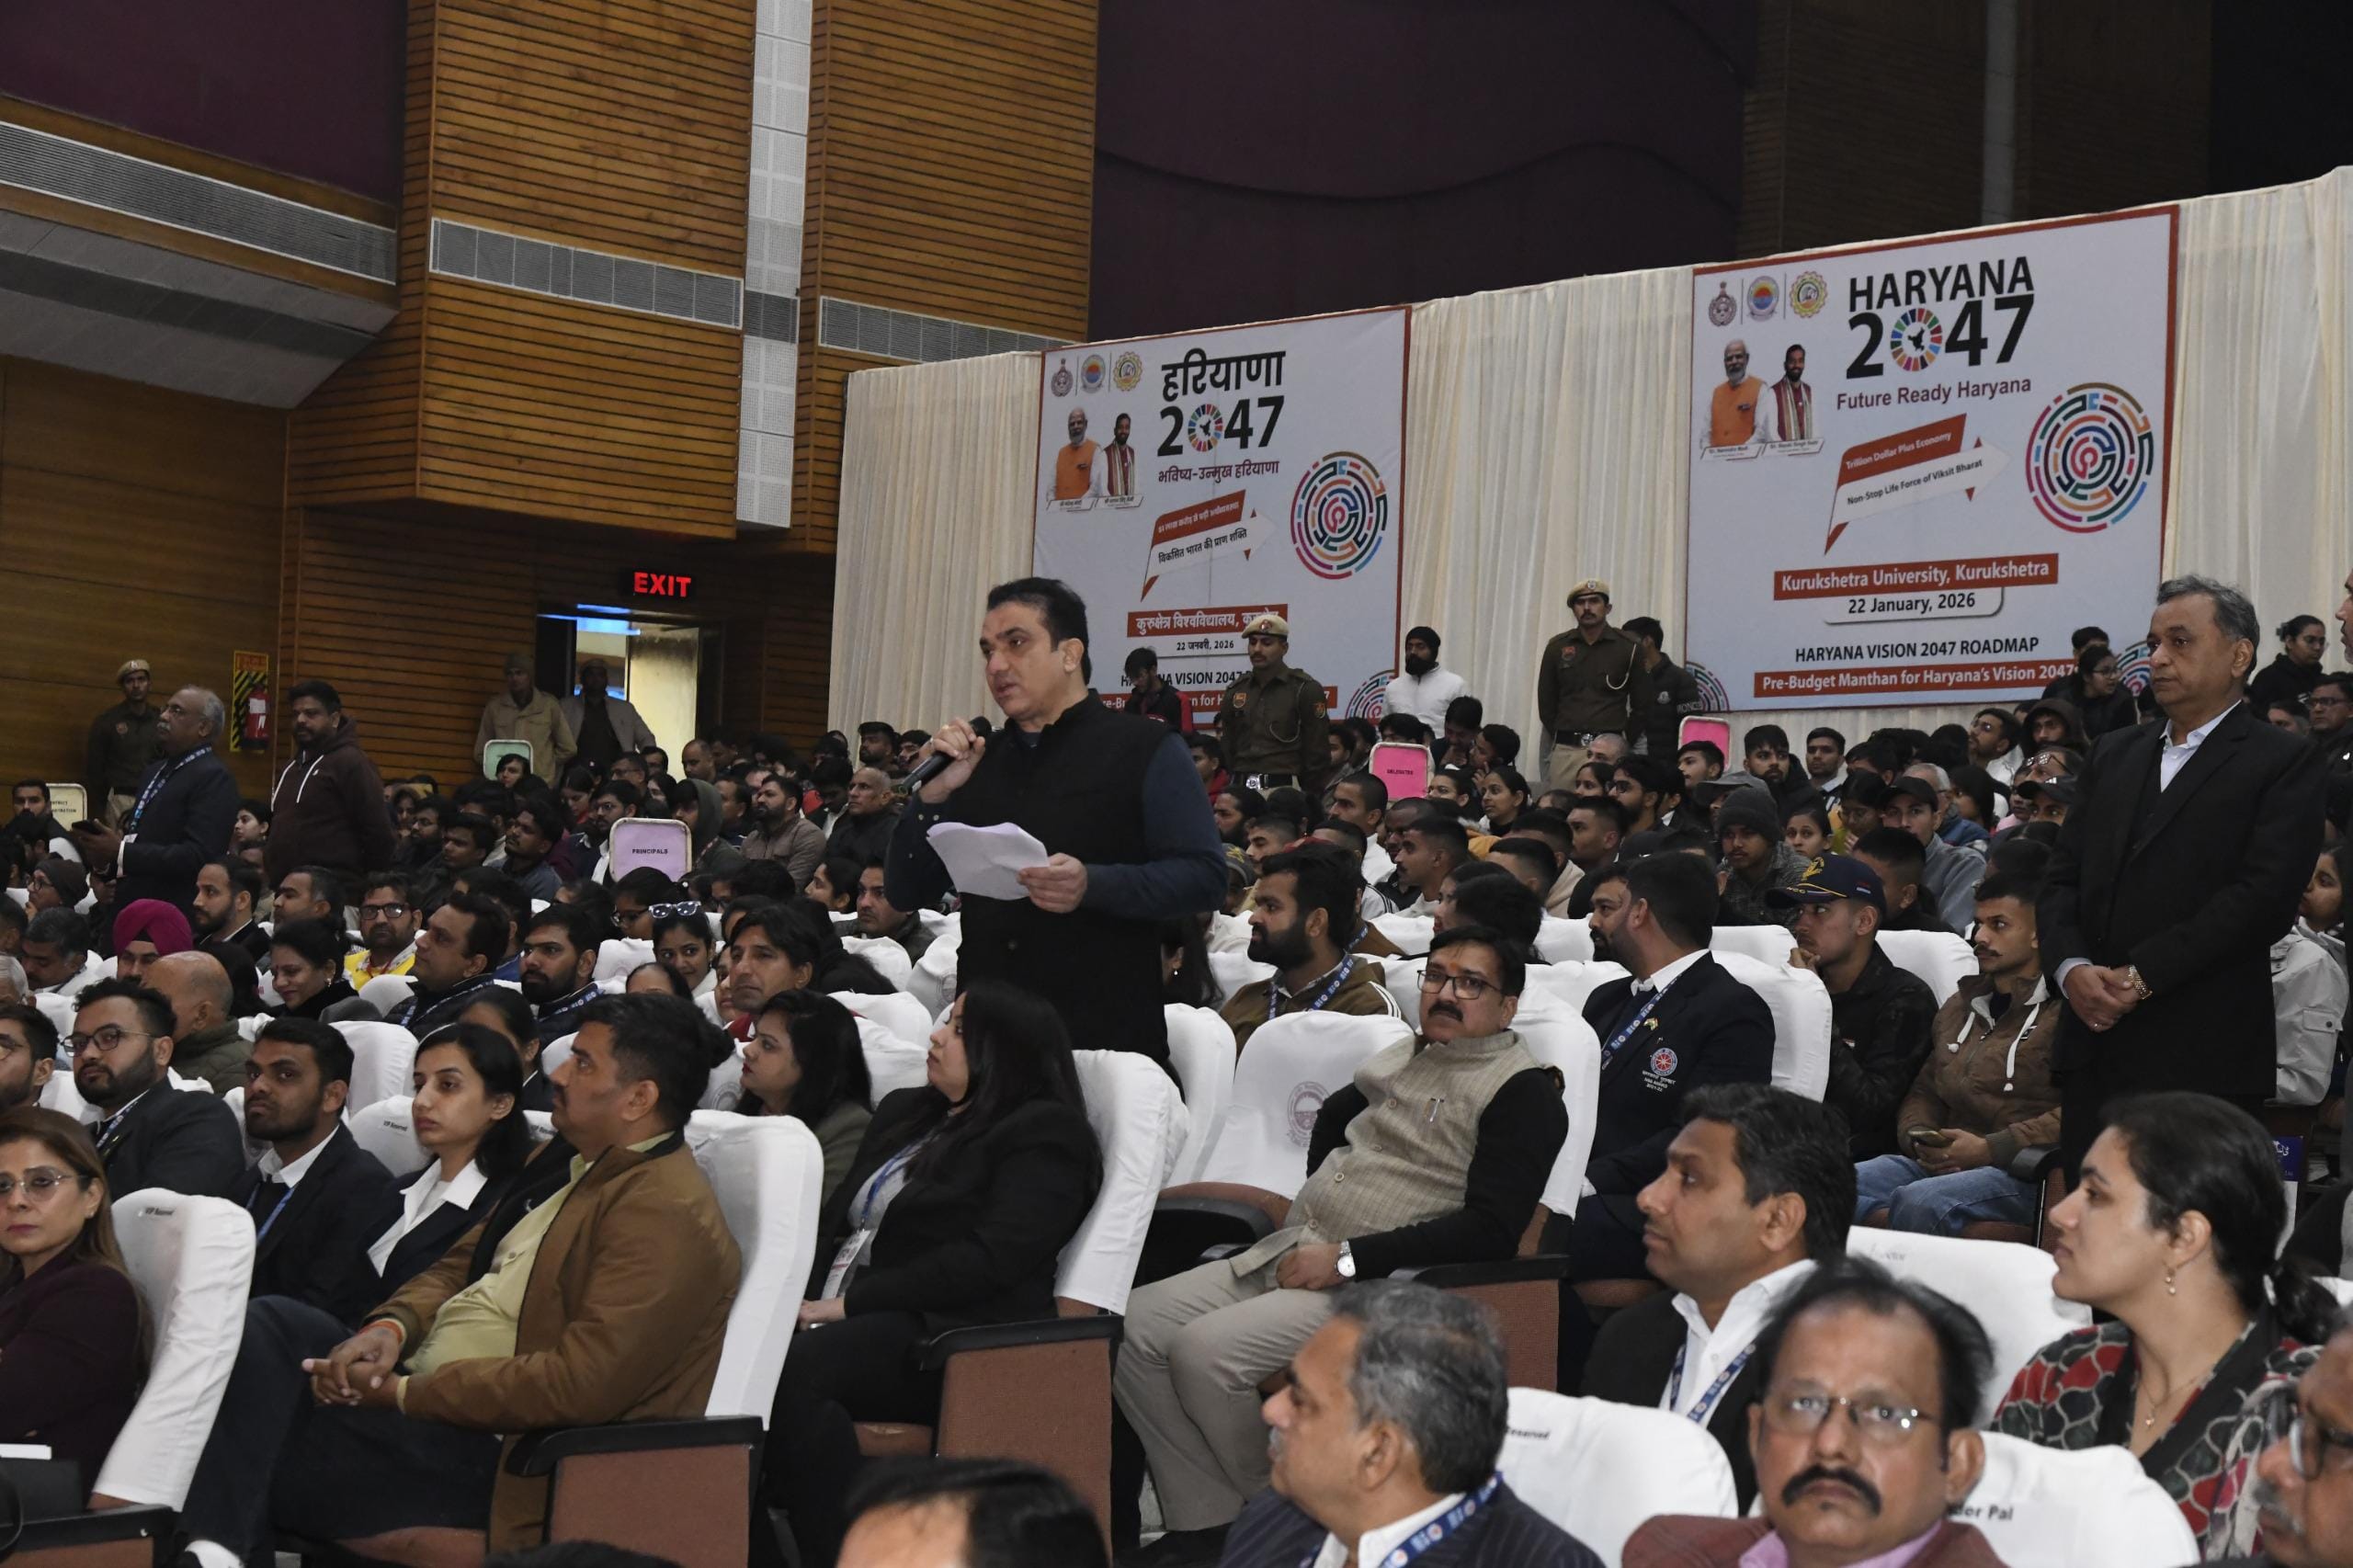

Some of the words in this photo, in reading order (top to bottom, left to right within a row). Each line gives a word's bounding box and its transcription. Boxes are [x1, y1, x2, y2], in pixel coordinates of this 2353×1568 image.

[1849, 256, 2034, 312] HARYANA
[1162, 347, 1286, 402] हरियाणा
[1837, 392, 1892, 410] Future
[1898, 384, 1951, 403] Ready
[1958, 379, 2031, 400] Haryana
[1874, 449, 1897, 461] Dollar
[1898, 443, 1915, 453] Plus
[1916, 432, 1952, 449] Economy
[1235, 459, 1279, 478] हरियाणा
[1847, 487, 1883, 505] Non-Stop
[1885, 483, 1899, 494] Life
[1901, 478, 1921, 489] Force
[1923, 472, 1932, 483] of
[1932, 467, 1954, 481] Viksit
[1956, 460, 1983, 472] Bharat
[1158, 547, 1184, 563] विकसित
[1186, 543, 1202, 555] भारत
[1203, 537, 1213, 549] की
[1230, 528, 1247, 541] शक्ति
[634, 572, 691, 597] EXIT
[1782, 573, 1868, 592] Kurukshetra
[1873, 565, 1950, 586] University,
[1956, 561, 2049, 581] Kurukshetra
[1848, 599, 1866, 614] 22
[1870, 594, 1932, 614] January,
[1938, 593, 1975, 609] 2026
[1136, 613, 1171, 636] कुरुक्षेत्र
[1176, 642, 1186, 651] 22
[1214, 641, 1234, 649] 2026
[1796, 645, 1863, 663] HARYANA
[1867, 642, 1916, 659] VISION
[1920, 642, 1956, 656] 2047
[1961, 637, 2040, 654] ROADMAP
[1176, 672, 1212, 685] VISION
[1763, 674, 1836, 691] Pre-Budget
[1838, 671, 1897, 687] Manthan
[1901, 670, 1920, 685] for
[1993, 665, 2035, 682] Vision
[1200, 696, 1215, 707] for
[1988, 1504, 2014, 1520] Pal
